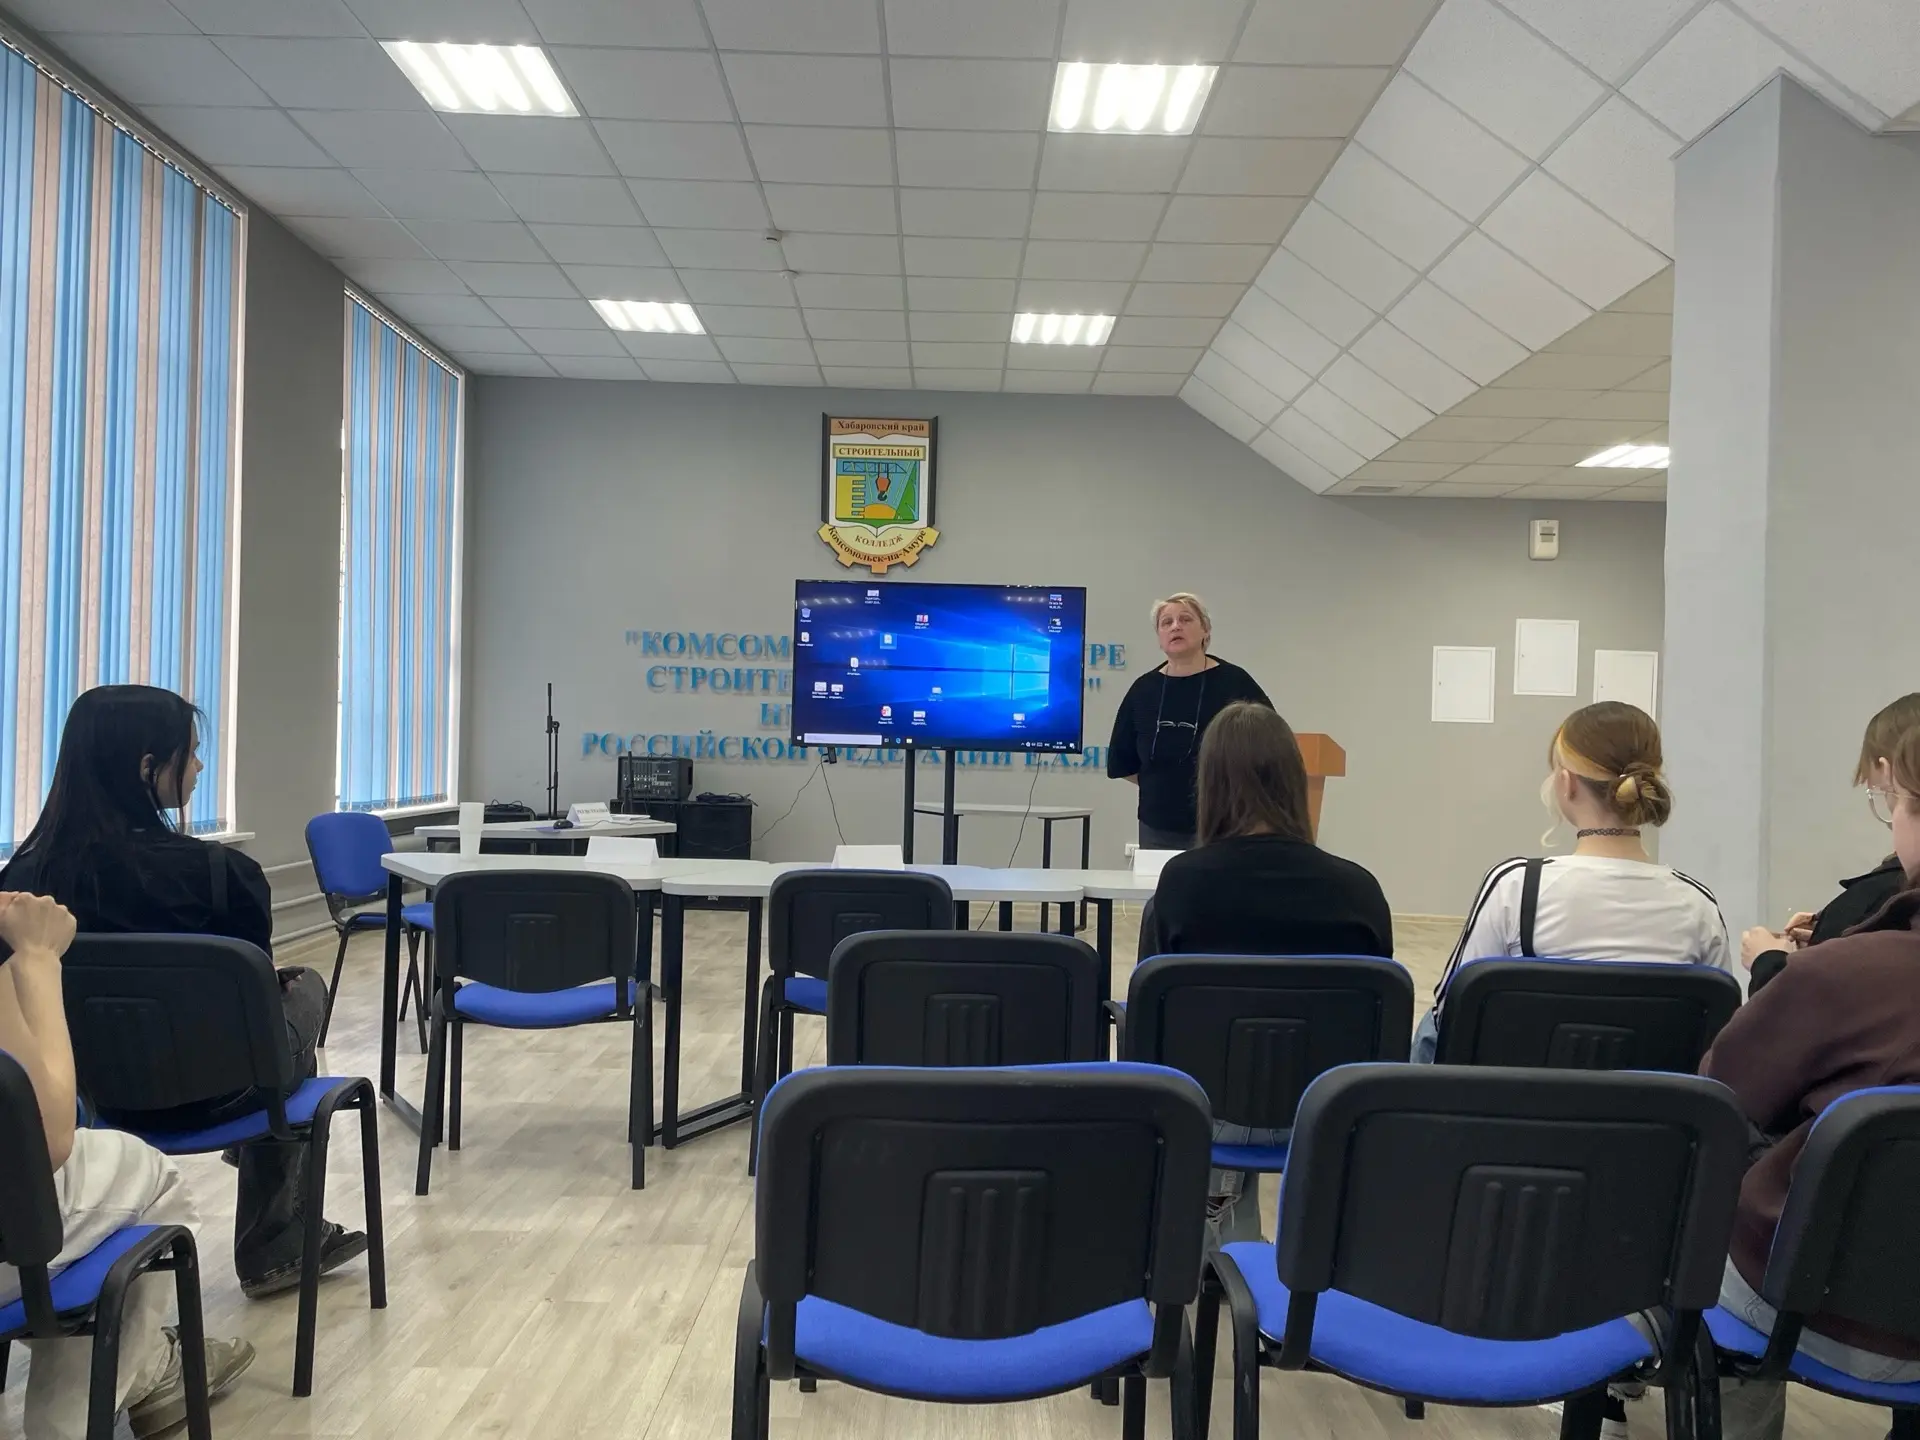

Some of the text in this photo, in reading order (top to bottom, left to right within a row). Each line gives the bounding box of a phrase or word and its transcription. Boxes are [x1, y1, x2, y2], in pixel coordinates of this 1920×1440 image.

[837, 420, 925, 433] Хабаровский край
[838, 446, 920, 457] СТРОИТЕЛЬНЫЙ
[828, 526, 927, 563] Комсомольск-на-Амуре
[855, 533, 904, 548] КОЛЛЕДЖ
[625, 630, 792, 660] "КОМСОМ
[646, 665, 792, 693] СТРОИТЕ
